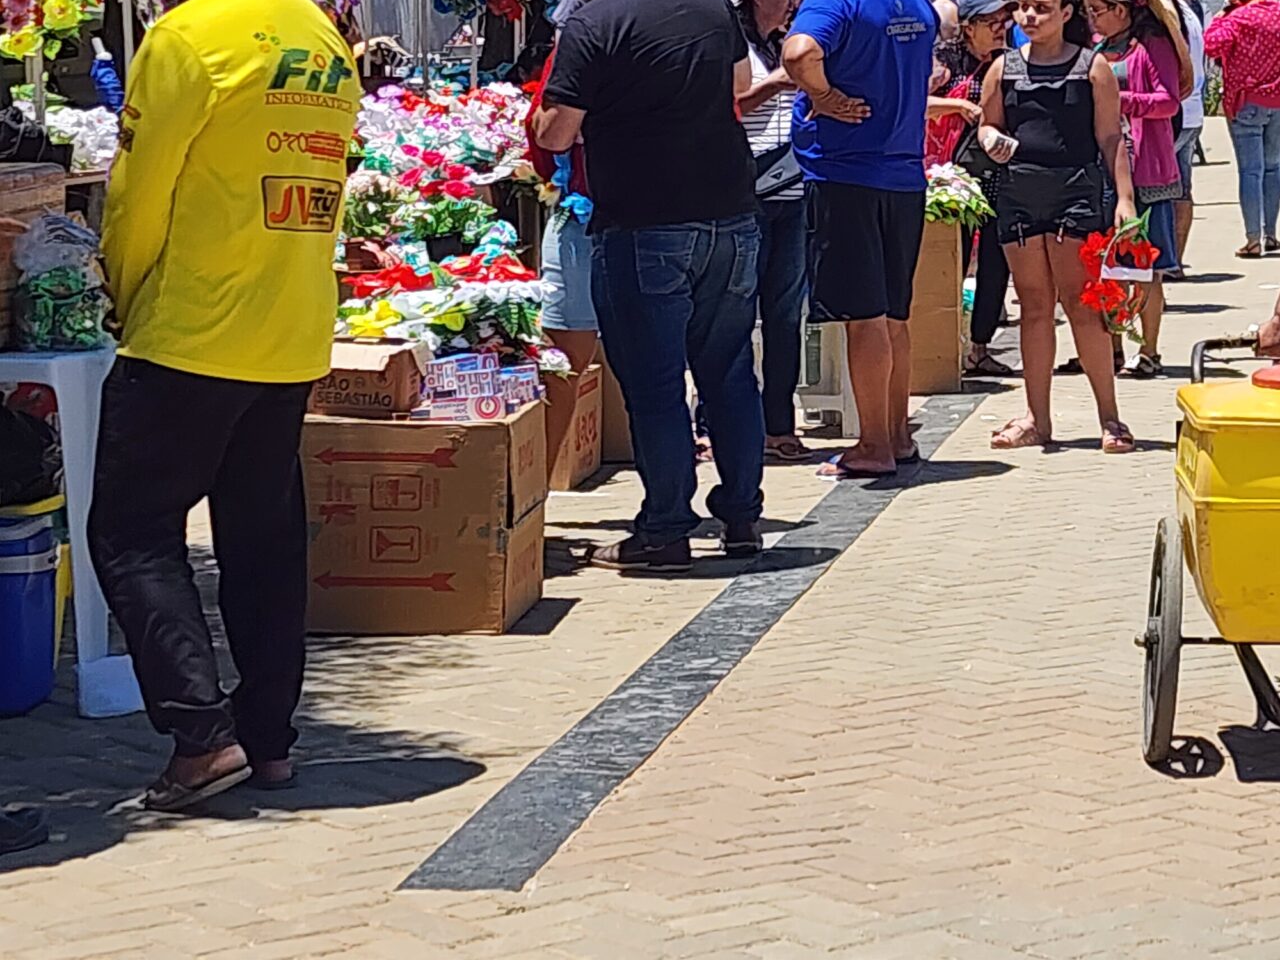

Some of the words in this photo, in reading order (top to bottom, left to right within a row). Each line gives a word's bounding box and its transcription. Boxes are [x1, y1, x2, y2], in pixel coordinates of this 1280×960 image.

[267, 48, 353, 94] Fit
[317, 375, 350, 391] SÃO
[316, 391, 393, 408] SEBASTIÃO
